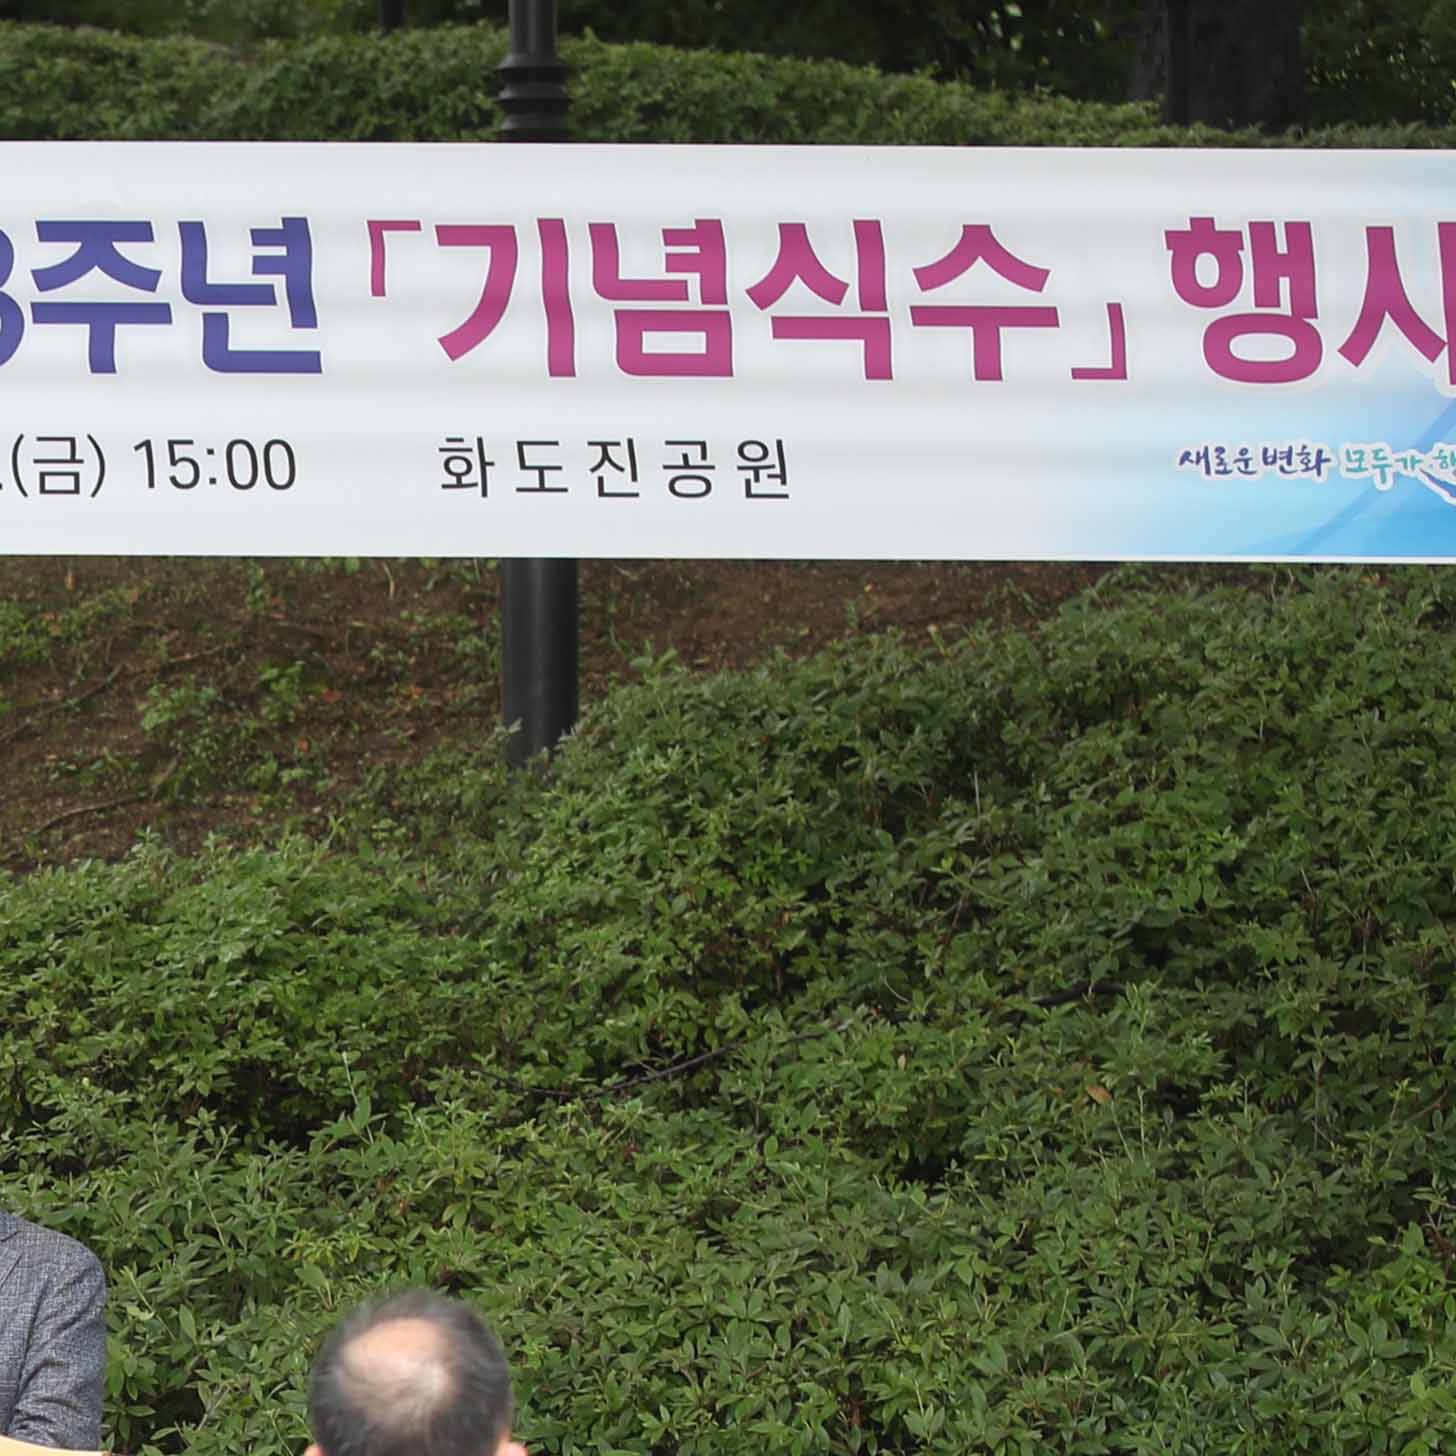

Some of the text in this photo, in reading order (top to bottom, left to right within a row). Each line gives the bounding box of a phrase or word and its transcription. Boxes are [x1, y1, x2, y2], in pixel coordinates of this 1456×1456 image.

[1164, 216, 1456, 385] 행사
[133, 438, 296, 491] 15:00
[438, 437, 792, 499] 화도진공원
